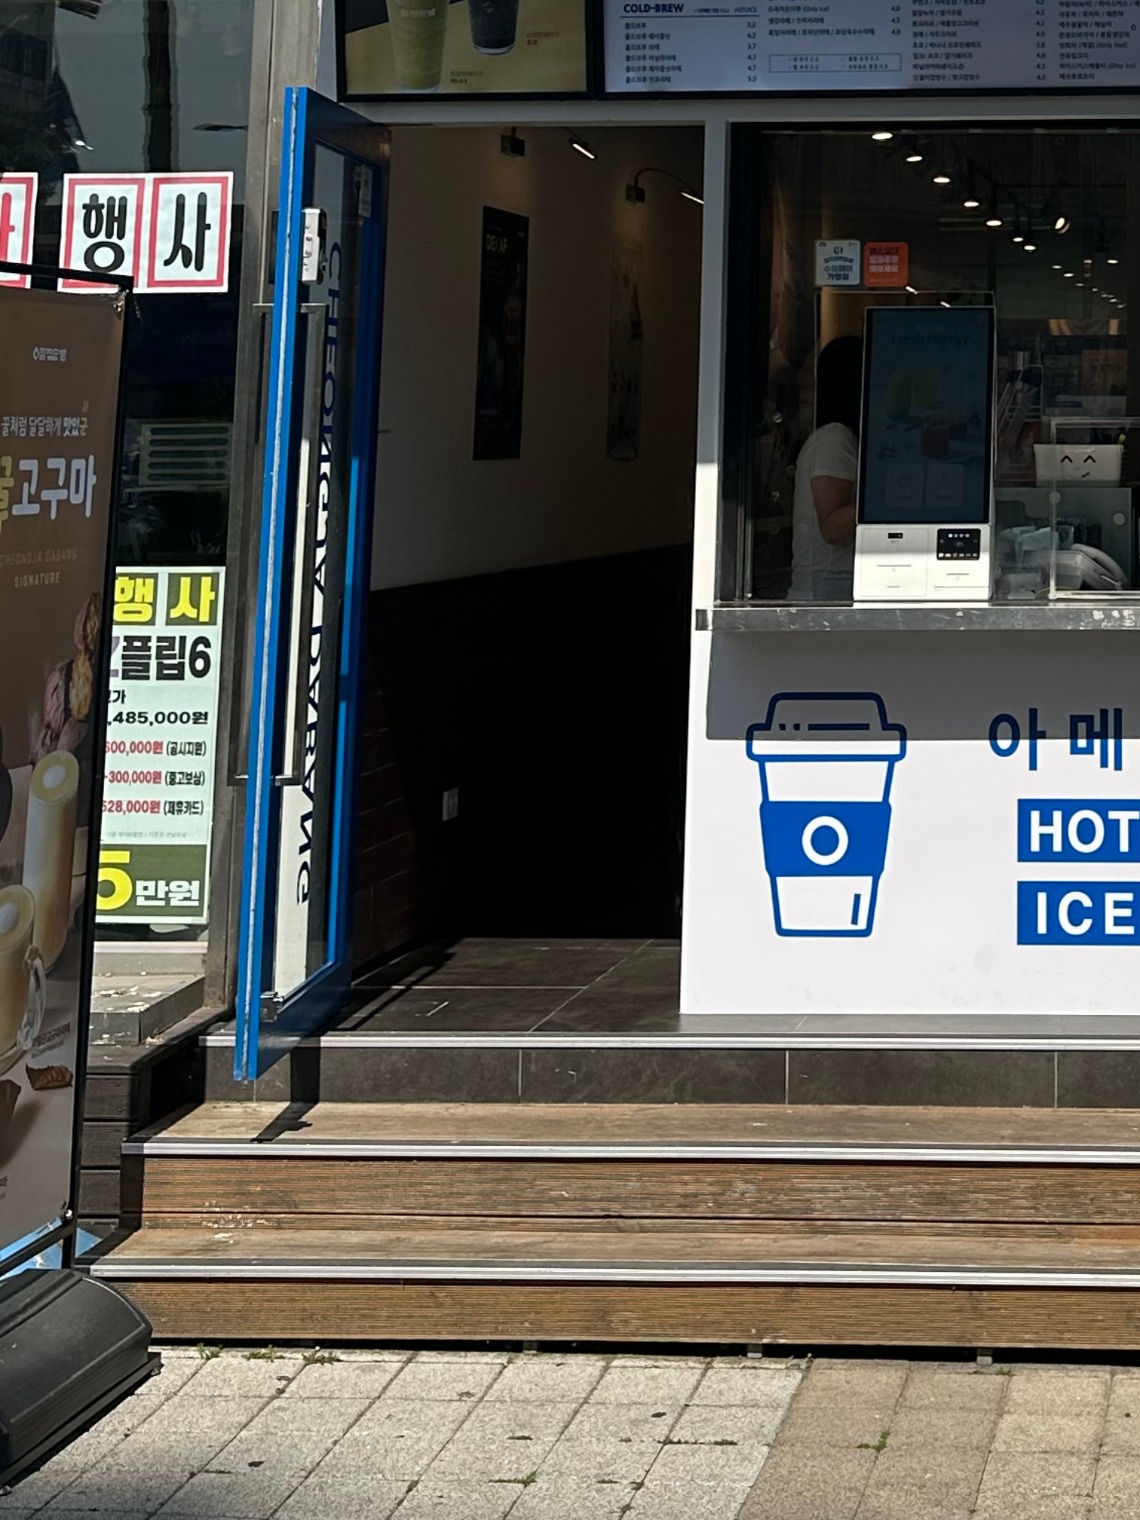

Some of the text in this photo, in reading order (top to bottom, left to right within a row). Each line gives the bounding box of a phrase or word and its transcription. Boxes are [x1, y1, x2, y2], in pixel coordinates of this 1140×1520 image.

[624, 3, 684, 14] COLD-BREW
[14, 571, 60, 588] SIGNATURE
[113, 576, 216, 624] 행사
[163, 800, 204, 817] (제휴카드)
[1028, 808, 1140, 854] HOT
[1036, 891, 1136, 936] ICE
